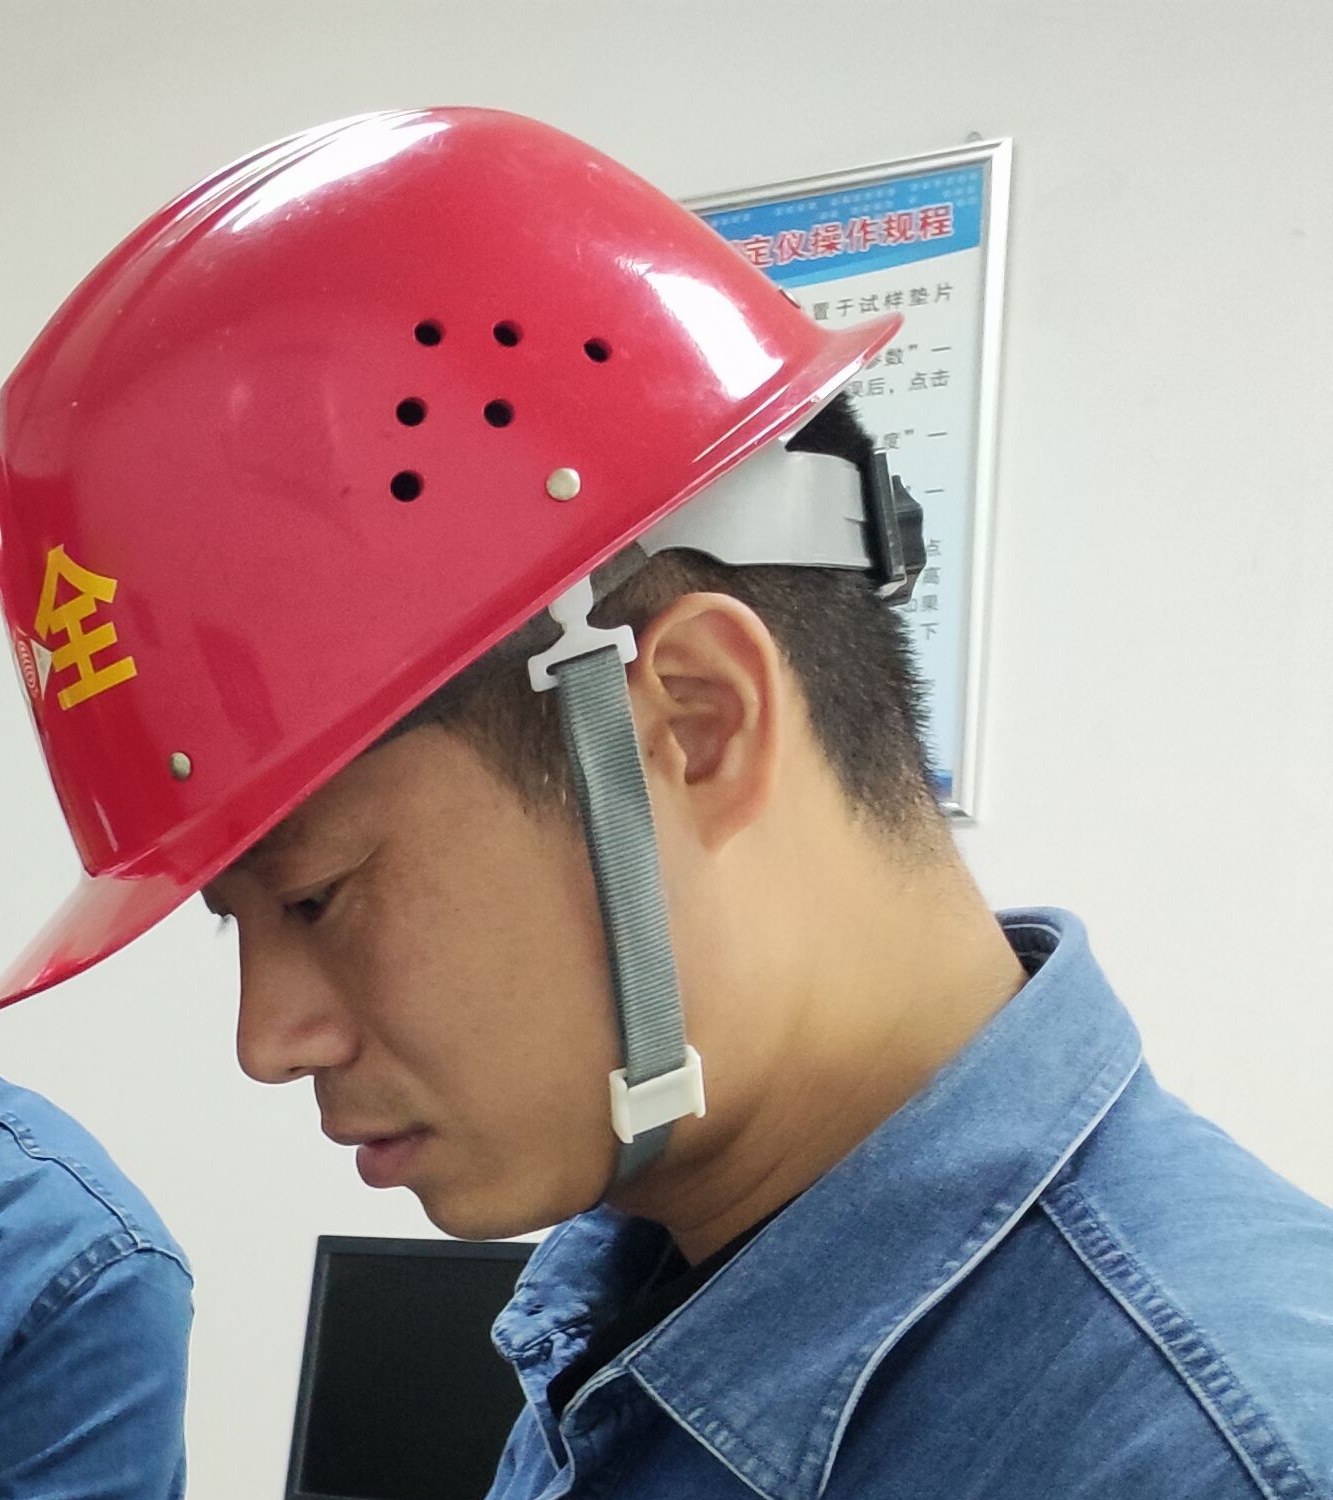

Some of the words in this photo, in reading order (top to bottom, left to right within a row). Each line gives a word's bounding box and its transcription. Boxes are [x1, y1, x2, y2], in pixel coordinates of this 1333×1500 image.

[812, 282, 953, 320] 置于试样垫片
[34, 544, 138, 711] 全
